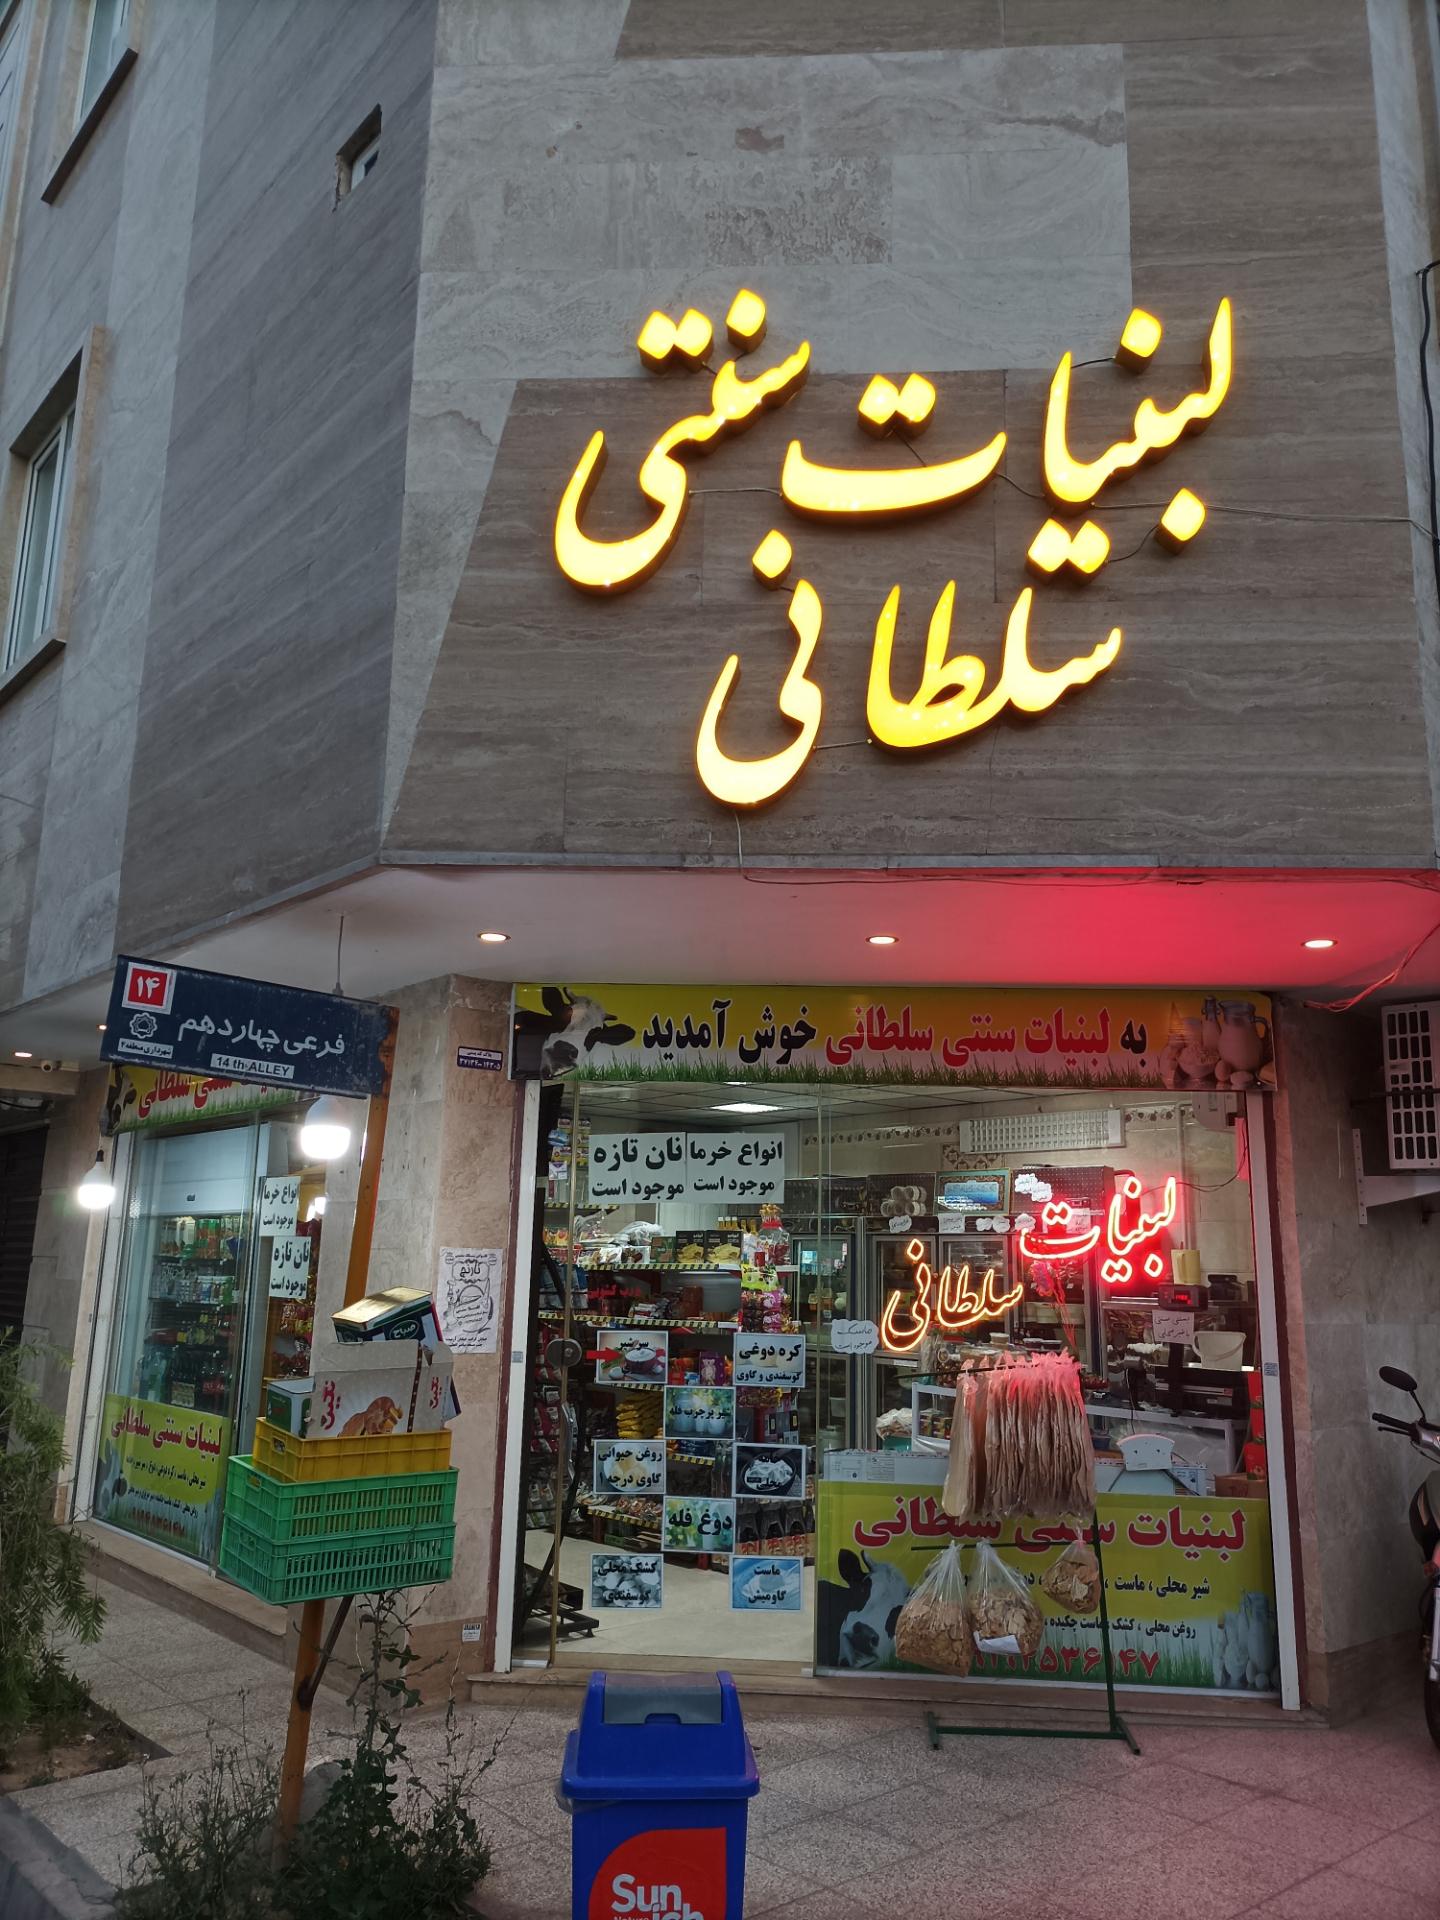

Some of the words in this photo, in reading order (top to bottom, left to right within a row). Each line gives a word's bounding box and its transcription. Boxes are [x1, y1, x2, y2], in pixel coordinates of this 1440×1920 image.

[553, 288, 812, 594] سنتی
[780, 296, 1232, 578] لبنیات
[695, 528, 1123, 811] سلطانی
[136, 976, 161, 999] ۱۴
[177, 1015, 280, 1052] چهاردهم
[642, 998, 732, 1061] آمدید
[738, 1005, 818, 1065] خوش
[825, 1003, 933, 1067] سلطانی
[942, 1013, 1016, 1068] سنتی
[1024, 1005, 1111, 1068] لبنیات
[283, 1033, 346, 1058] فرعی
[1120, 1018, 1148, 1068] به
[217, 1056, 230, 1068] 14
[248, 1061, 290, 1076] ALLEY
[593, 1137, 639, 1172] تازه
[645, 1136, 683, 1170] نان
[690, 1141, 732, 1167] خرما
[737, 1140, 783, 1166] انواع
[263, 1183, 280, 1205] خرما
[281, 1183, 298, 1205] نواع
[591, 1178, 628, 1197] است
[631, 1180, 685, 1200] موجود
[693, 1175, 725, 1192] است
[728, 1177, 775, 1196] موجود
[262, 1212, 276, 1226] است
[276, 1214, 294, 1230] موجود
[1018, 1175, 1178, 1283] لبنیات
[273, 1240, 293, 1269] تازه
[293, 1240, 310, 1269] نان
[270, 1274, 286, 1290] است
[285, 1279, 307, 1296] موجود
[880, 1238, 1025, 1353] سلطانی
[739, 1342, 776, 1361] دوغی
[779, 1344, 802, 1362] کره
[765, 1370, 802, 1384] گوسفندی
[111, 1405, 151, 1439] سلطانی
[152, 1416, 183, 1449] سنتی
[185, 1422, 223, 1463] لبنیات
[598, 1446, 634, 1462] حیوانی
[636, 1447, 663, 1462] روغن
[606, 1474, 635, 1488] درجه
[636, 1472, 662, 1487] گاوی
[669, 1508, 693, 1527] فله
[698, 1508, 733, 1536] دوغ
[854, 1495, 1002, 1548] سطانی
[1128, 1506, 1246, 1561] لبنیات
[597, 1560, 627, 1576] محلی
[629, 1561, 658, 1574] کشک
[753, 1564, 781, 1576] ماست
[1114, 1574, 1146, 1592] ماست
[1155, 1576, 1188, 1598] محلی
[1190, 1577, 1210, 1600] شیر
[1051, 1615, 1078, 1633] چکیده
[1113, 1618, 1136, 1631] کشک
[1146, 1619, 1171, 1637] محلی
[1172, 1620, 1196, 1639] روغن
[611, 1873, 682, 1912] Sun
